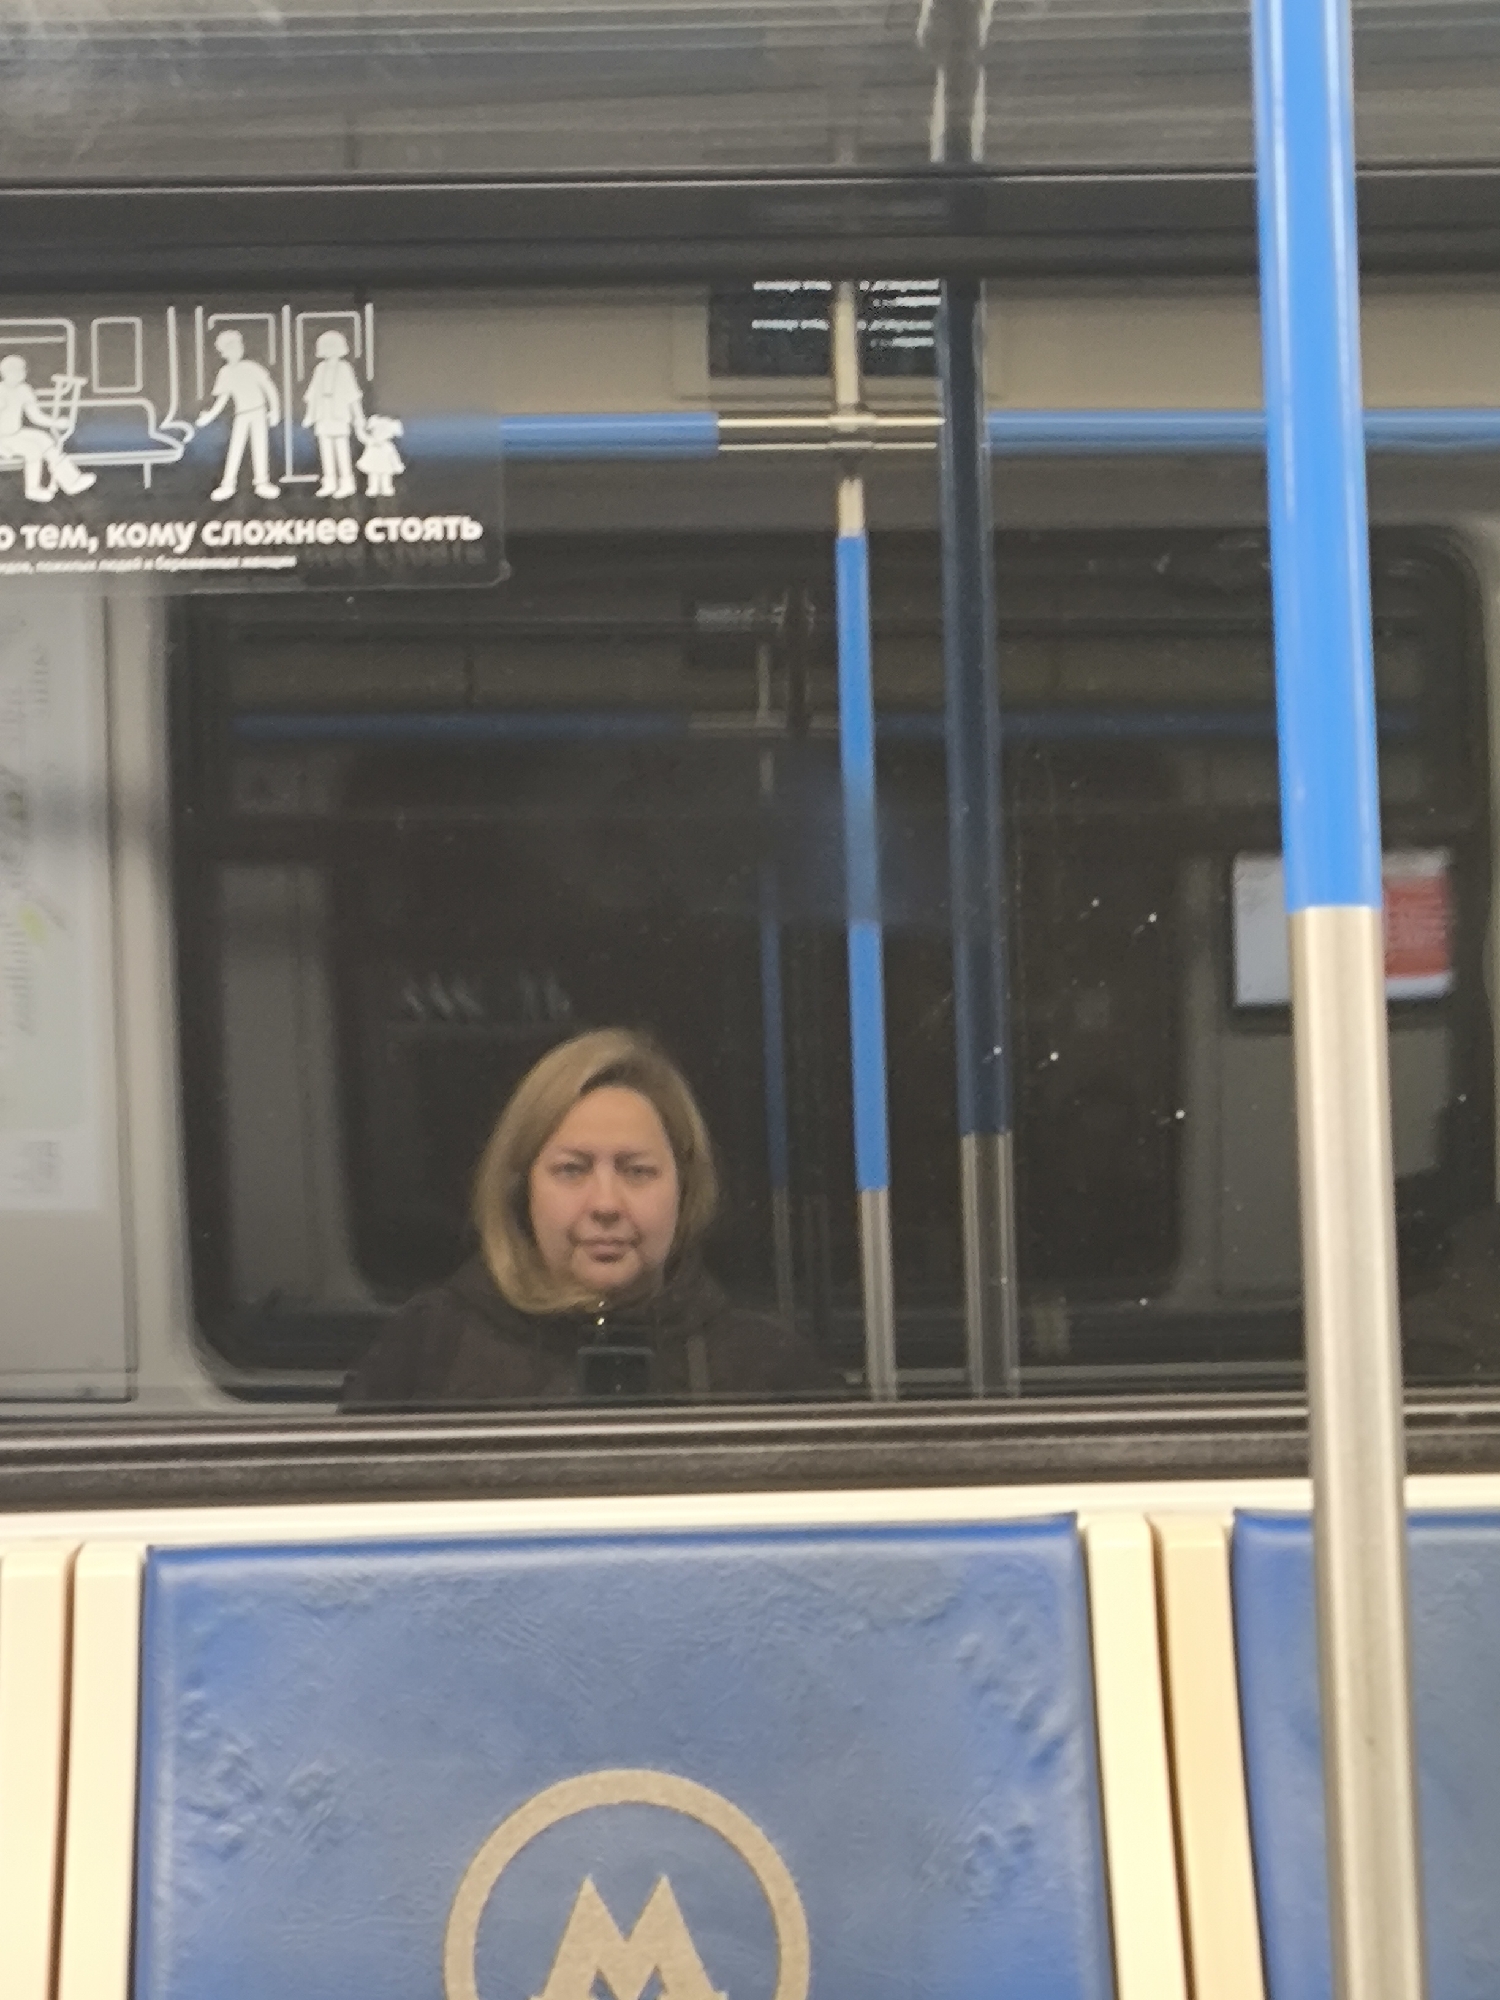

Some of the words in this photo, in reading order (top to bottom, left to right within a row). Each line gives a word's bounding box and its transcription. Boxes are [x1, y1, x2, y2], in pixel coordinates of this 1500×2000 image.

[20, 524, 99, 554] тем,
[106, 521, 197, 553] кому
[201, 518, 359, 545] сложнее
[364, 516, 483, 542] стоять
